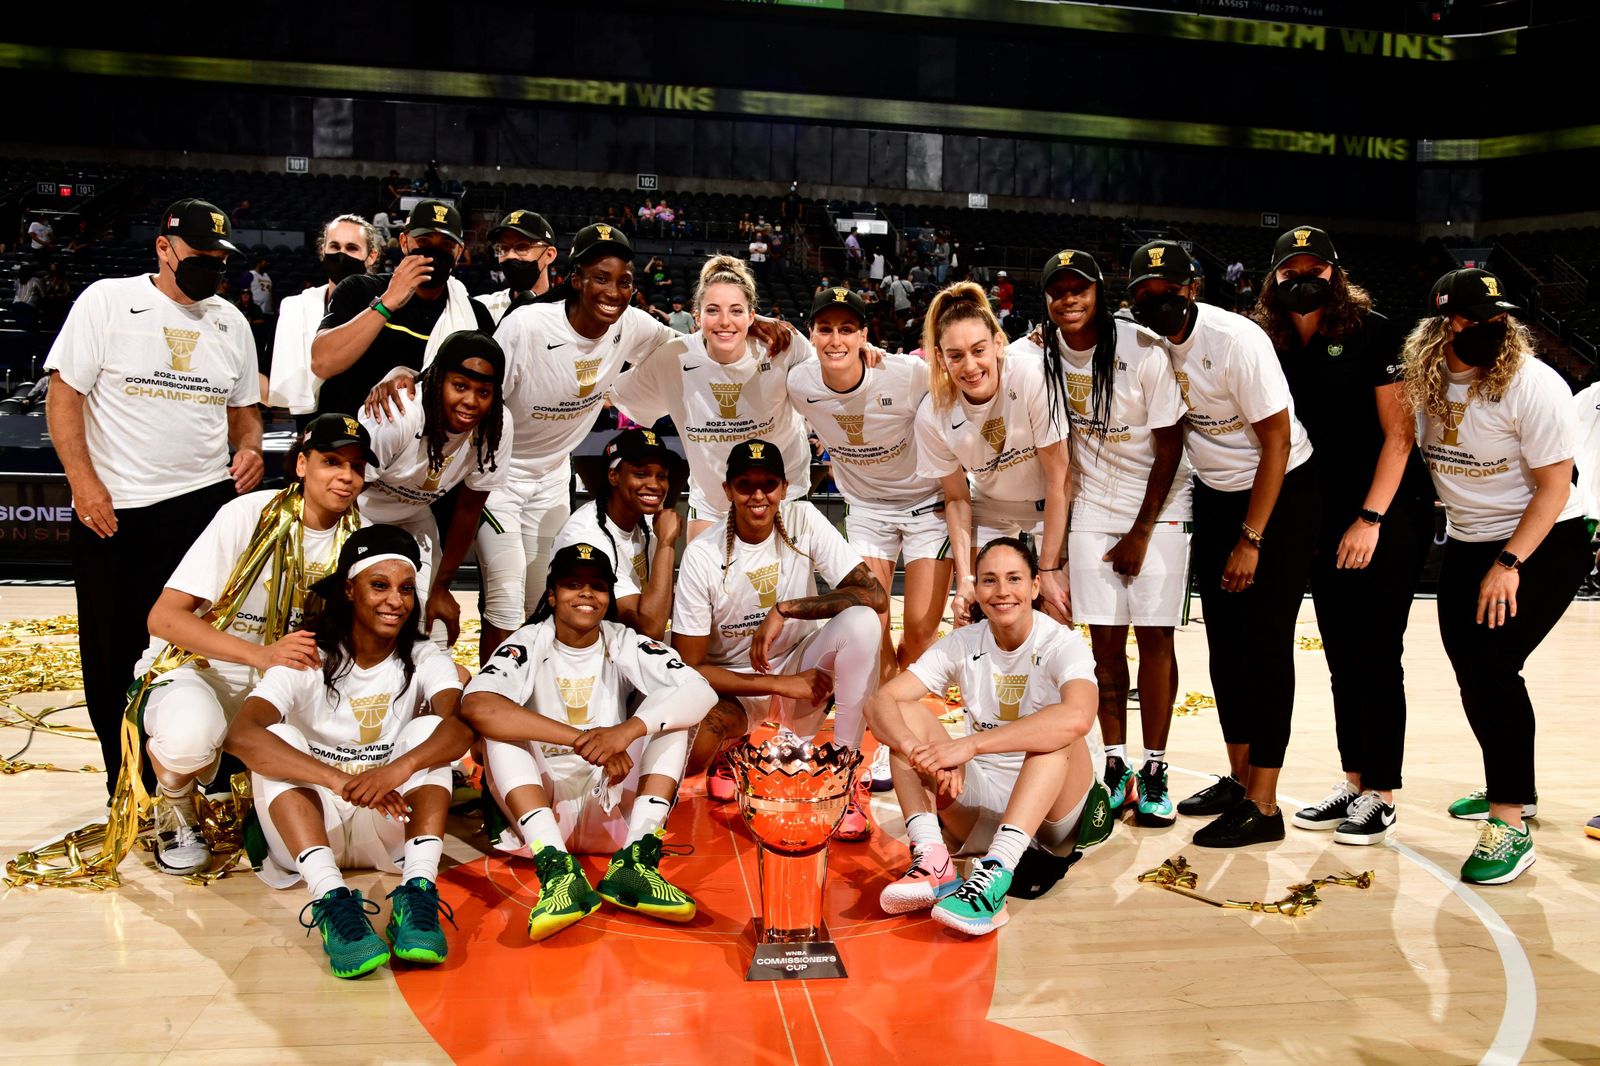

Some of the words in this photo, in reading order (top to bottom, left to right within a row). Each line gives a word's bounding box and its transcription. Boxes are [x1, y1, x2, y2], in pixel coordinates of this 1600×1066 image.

[1172, 15, 1327, 52] STORM
[1340, 29, 1454, 62] WINS
[523, 77, 626, 106] STORM
[634, 83, 714, 111] WINS
[1249, 128, 1336, 155] STORM
[1342, 135, 1408, 161] WINS
[290, 159, 305, 170] 101
[640, 177, 655, 187] 102
[41, 184, 53, 193] 124
[1263, 215, 1277, 225] 104
[153, 370, 177, 380] 2021
[178, 375, 209, 384] WNBA
[125, 377, 211, 392] COMMISSIONER'S
[124, 385, 226, 406] CHAMPIONS
[728, 419, 755, 427] WNBA
[1218, 415, 1239, 425] CUP
[685, 424, 758, 433] COMMISSIONER'S
[687, 423, 775, 443] CHAMPIONS
[1109, 425, 1130, 433] CUP
[1428, 444, 1447, 454] 2021
[1447, 449, 1476, 460] WNBA
[1482, 457, 1507, 467] CUP
[744, 612, 767, 621] 2021
[364, 742, 395, 752] WNBA
[756, 955, 837, 965] COMMISSIONER'S
